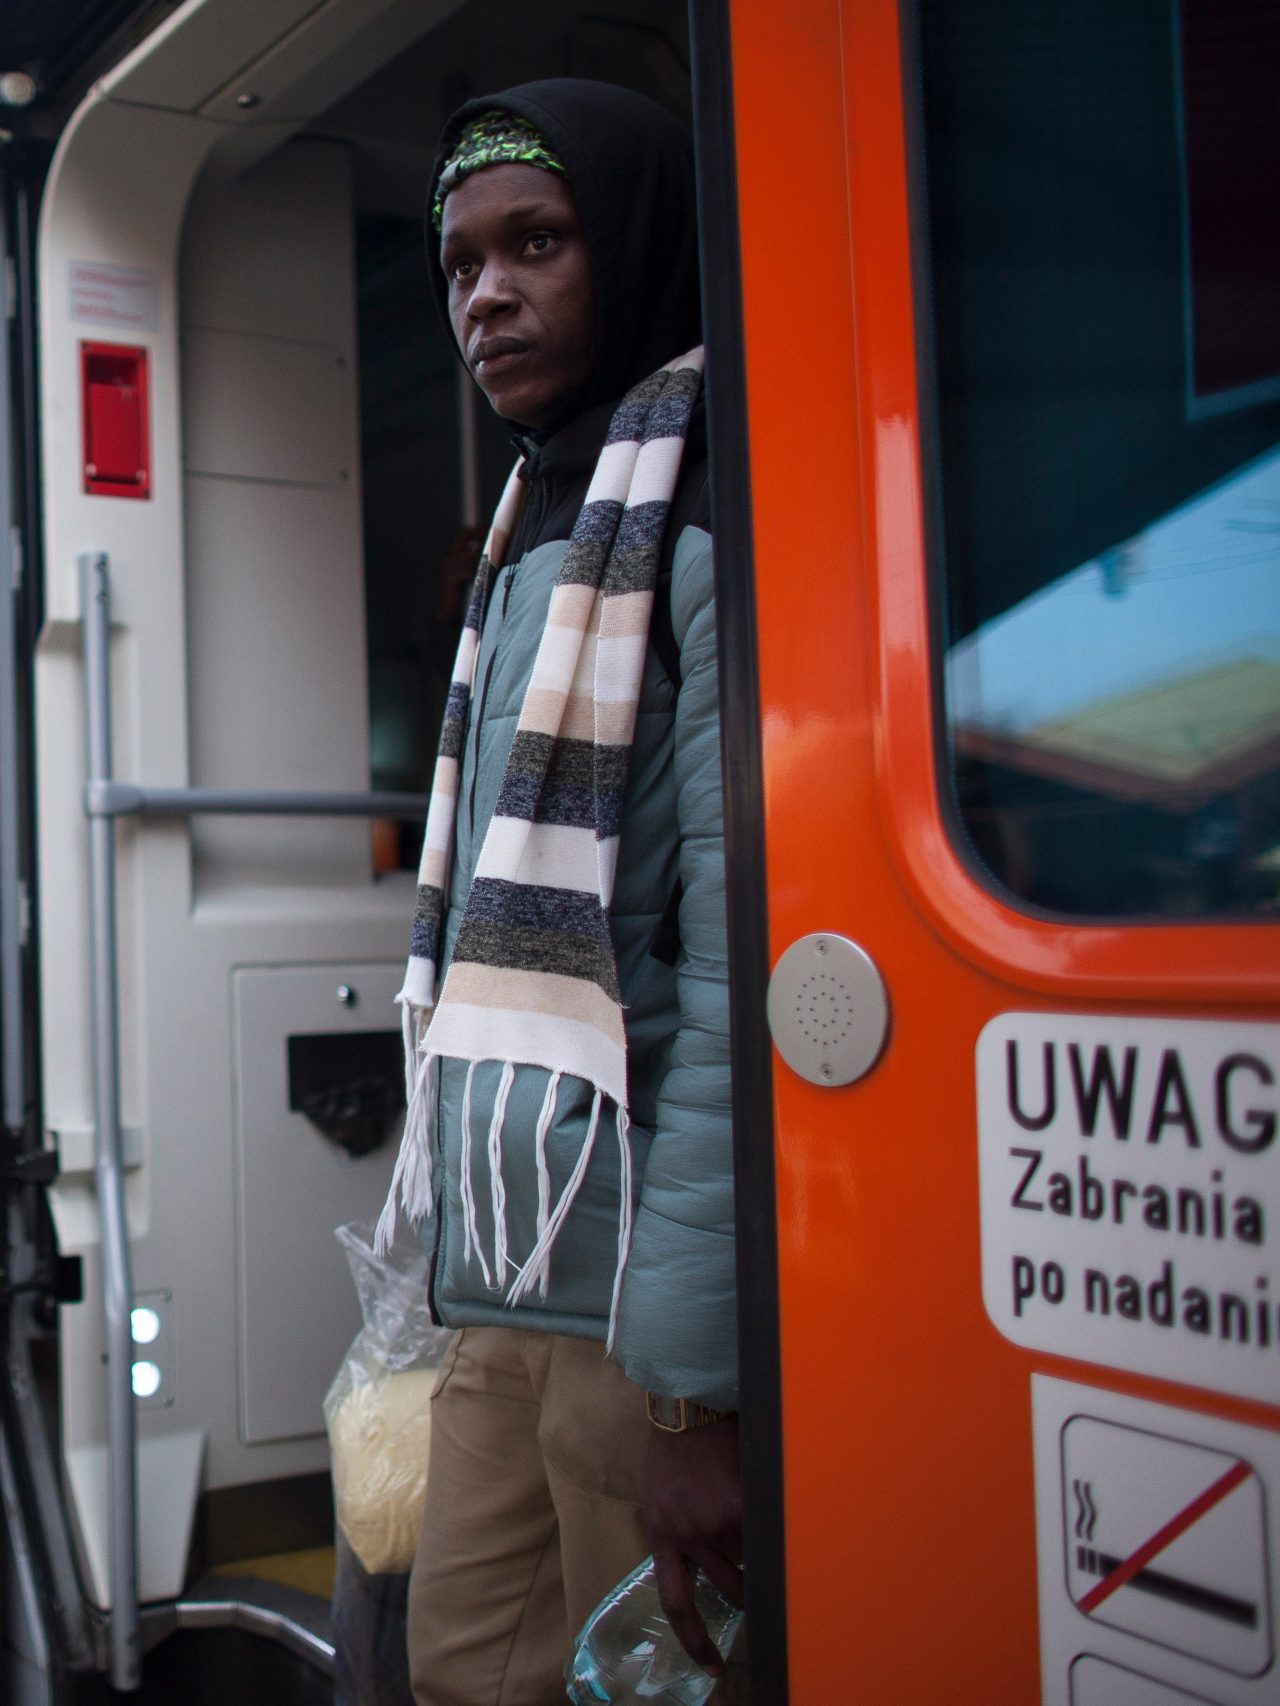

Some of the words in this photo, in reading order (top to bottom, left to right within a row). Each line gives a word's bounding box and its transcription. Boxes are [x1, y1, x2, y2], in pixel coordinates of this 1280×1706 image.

[1009, 1147, 1266, 1247] Zabrania
[1012, 1255, 1065, 1318] po
[1084, 1260, 1280, 1351] nadani
